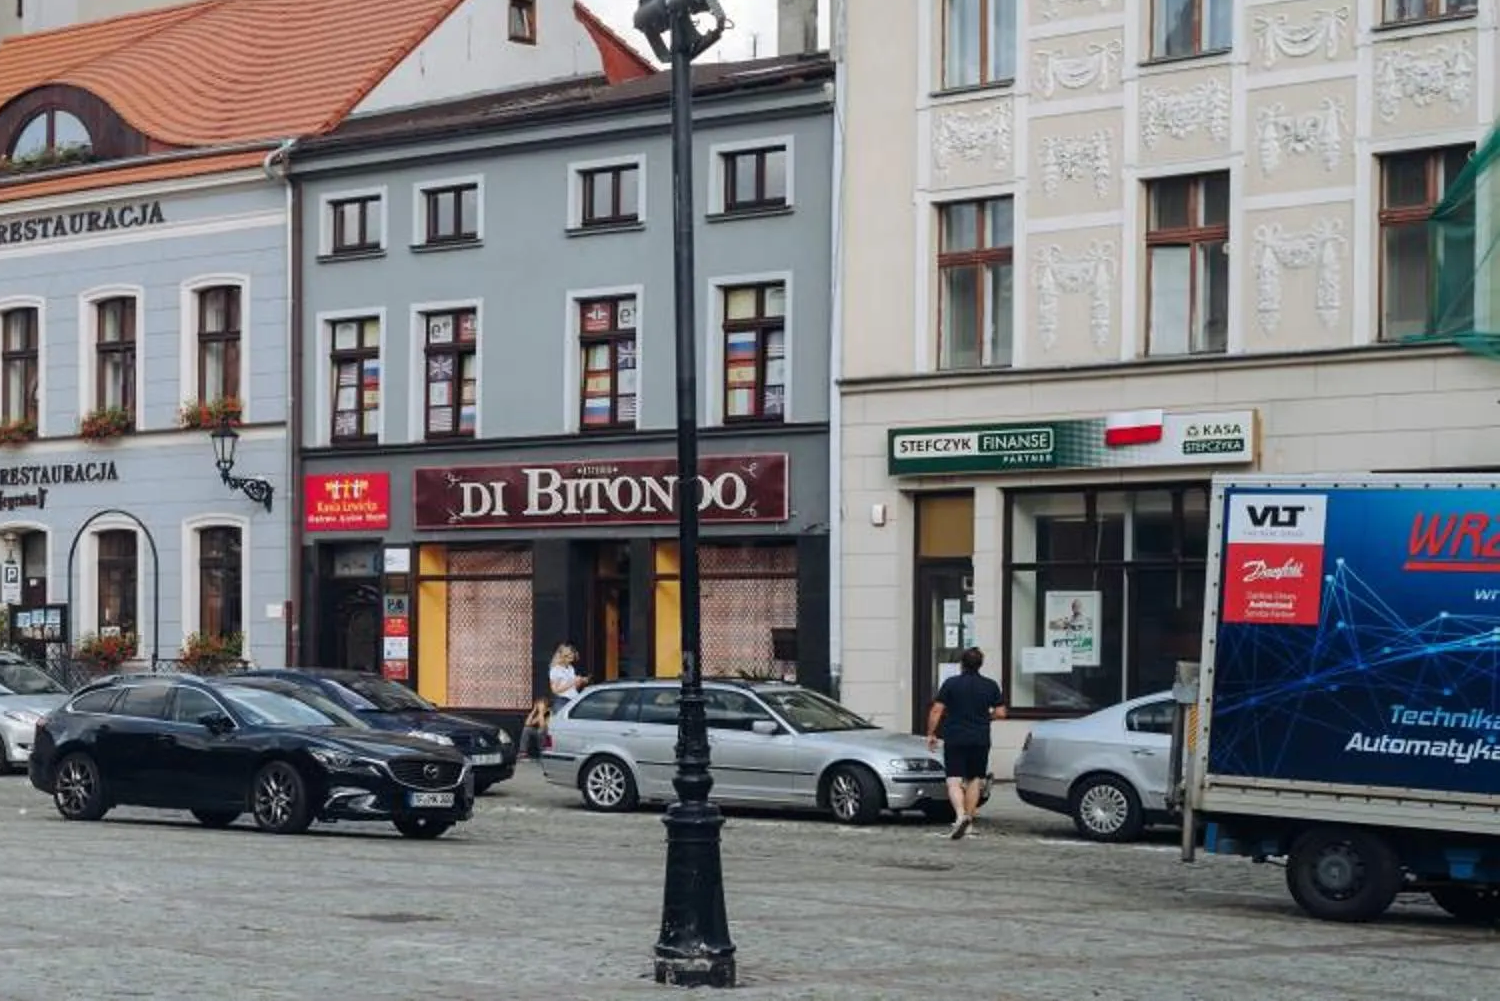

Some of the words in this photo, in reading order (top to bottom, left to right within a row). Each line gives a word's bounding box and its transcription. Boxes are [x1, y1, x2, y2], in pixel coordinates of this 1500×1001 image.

[1203, 423, 1242, 436] KASA
[899, 438, 972, 453] STEFCZYK
[983, 432, 1049, 451] FINANSE
[0, 461, 119, 486] RESTAURACJA
[459, 481, 509, 517] DI
[1246, 505, 1305, 527] VLT
[7, 567, 17, 582] P
[1390, 704, 1500, 730] Technika
[1344, 732, 1500, 764] Automatyka
